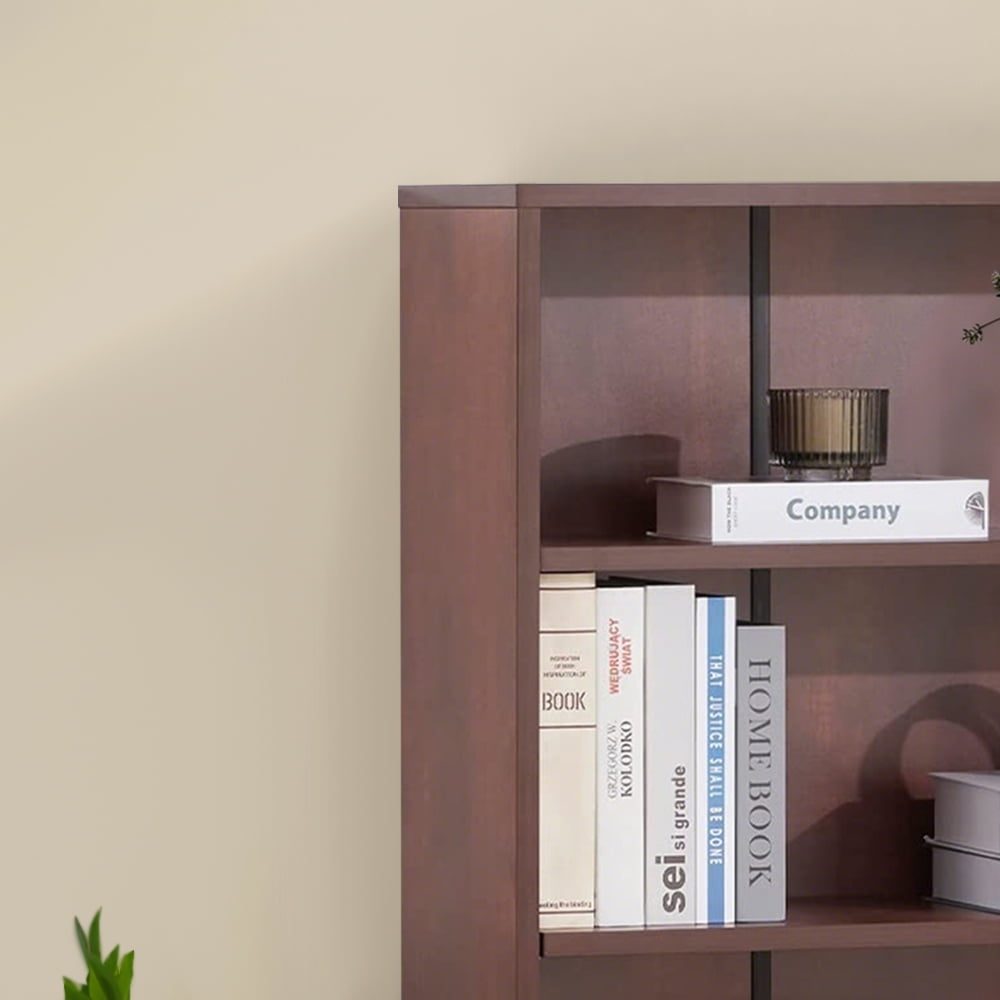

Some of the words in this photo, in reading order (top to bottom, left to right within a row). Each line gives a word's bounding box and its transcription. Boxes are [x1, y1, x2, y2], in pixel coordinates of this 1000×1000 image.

[786, 497, 900, 526] Company
[710, 655, 723, 687] THAT
[542, 691, 586, 711] BOOK
[748, 659, 772, 771] HOME
[710, 695, 723, 749] JUSTICE
[607, 737, 618, 799] GRZEGORZ
[710, 757, 723, 798] SHALL
[670, 765, 689, 830] grande
[710, 806, 723, 822] BE
[670, 834, 686, 851] si
[710, 828, 723, 865] DONE
[748, 781, 772, 887] BOOK
[655, 854, 686, 914] sei
